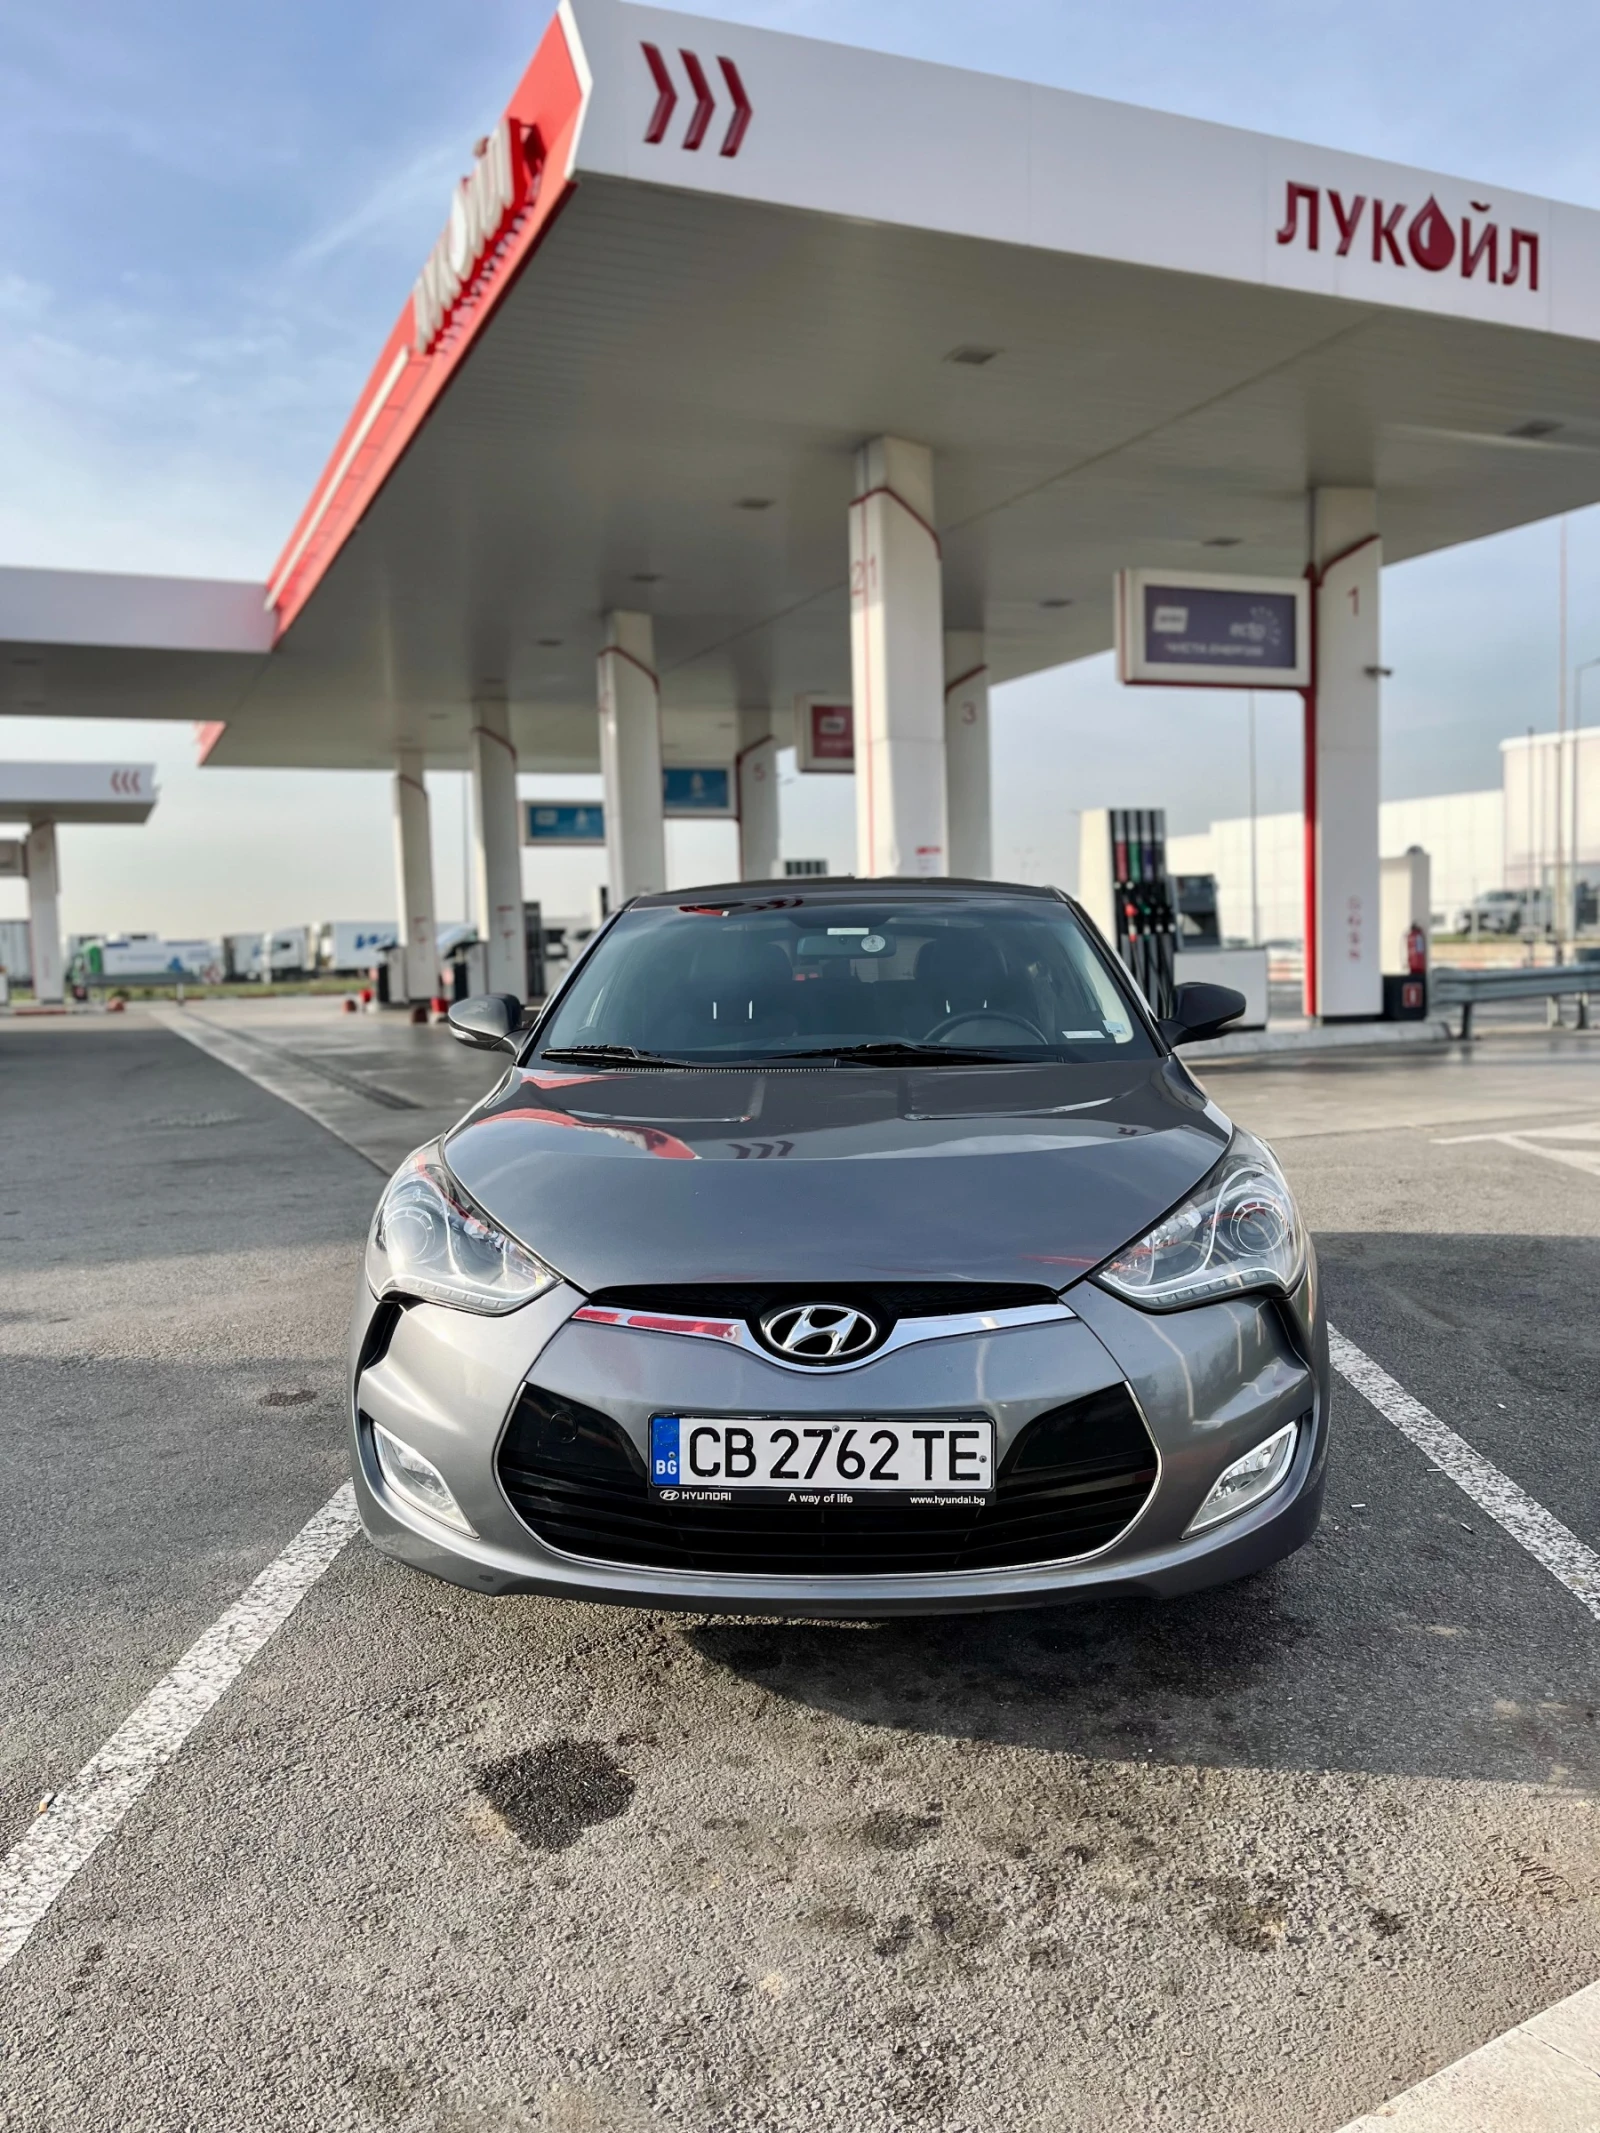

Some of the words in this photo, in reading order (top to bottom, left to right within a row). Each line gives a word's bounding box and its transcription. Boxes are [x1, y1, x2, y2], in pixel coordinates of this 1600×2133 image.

[1276, 180, 1539, 291] ЛУКОЙЛ
[1346, 586, 1360, 617] 1
[961, 700, 976, 725] 3
[656, 1459, 677, 1475] BG
[690, 1427, 756, 1477] CB
[770, 1429, 899, 1480] 2762
[913, 1430, 980, 1481] TE
[682, 1491, 732, 1501] HYUNDAI
[788, 1493, 797, 1502] A
[800, 1495, 820, 1505] way
[824, 1494, 834, 1503] of
[836, 1494, 854, 1503] life
[910, 1496, 986, 1506] www.hyundai.bg
